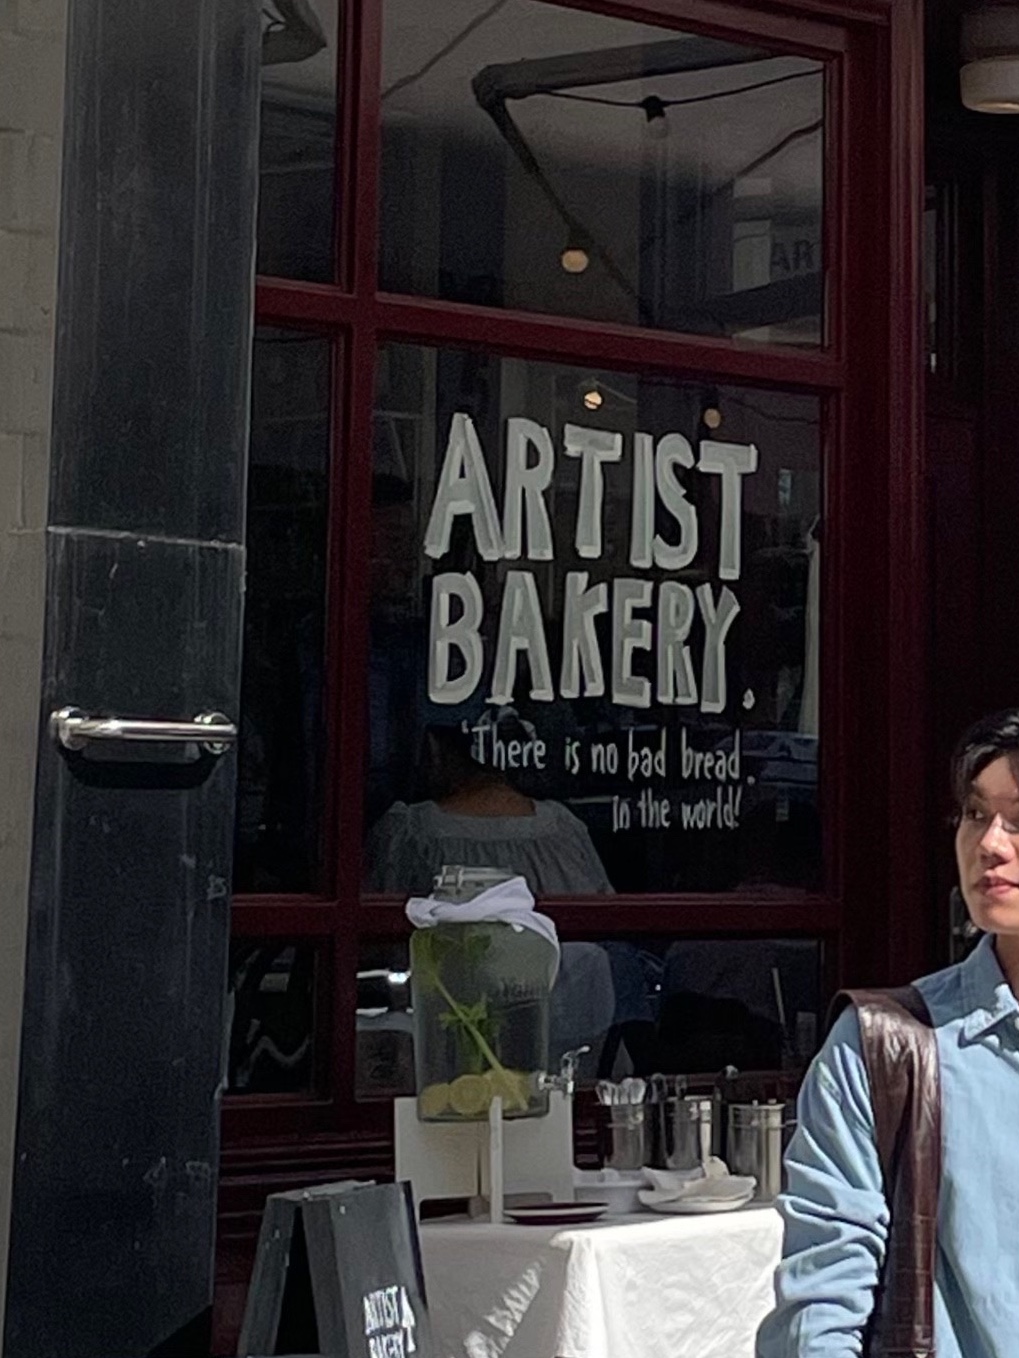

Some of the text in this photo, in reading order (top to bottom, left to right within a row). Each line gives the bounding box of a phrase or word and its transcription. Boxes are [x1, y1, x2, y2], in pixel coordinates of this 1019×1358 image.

[423, 412, 759, 581] ARTIST
[427, 570, 757, 714] BAKERY.
[564, 736, 581, 776] is
[591, 741, 618, 777] no
[626, 726, 667, 782] bad
[636, 787, 671, 828] the
